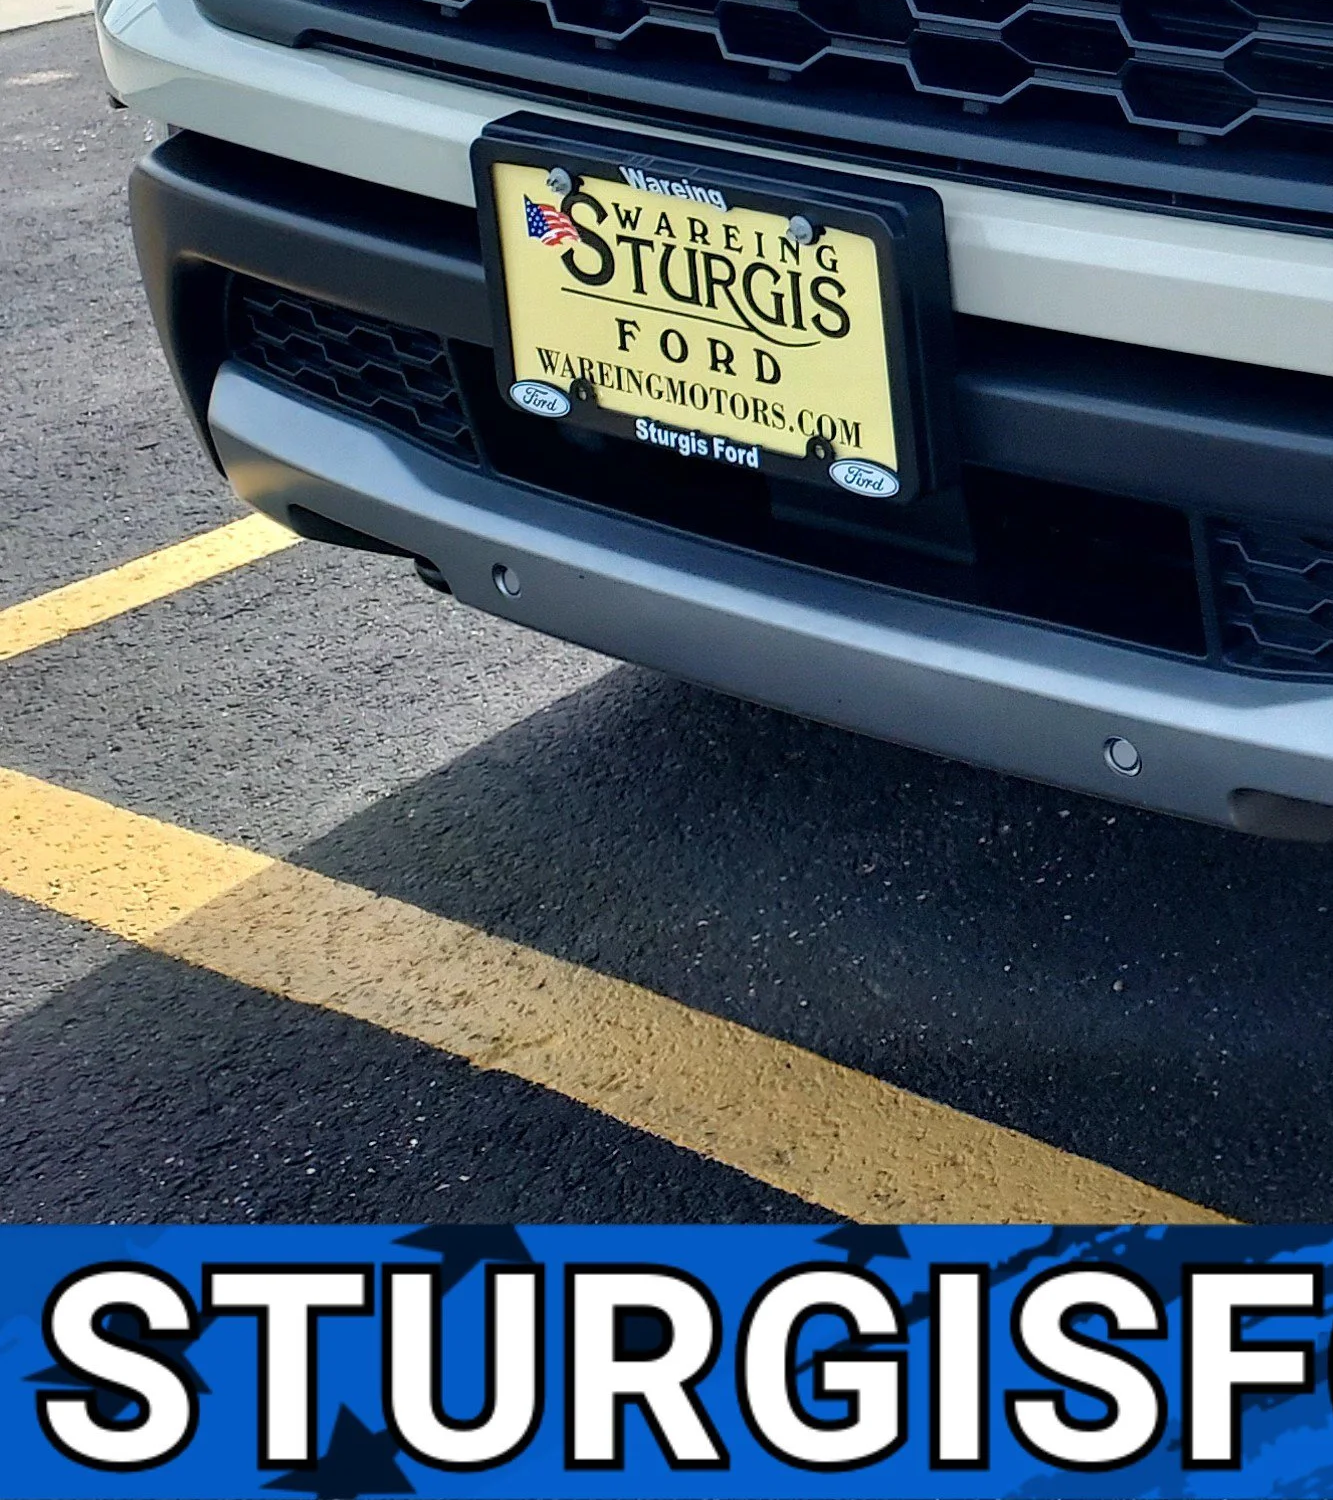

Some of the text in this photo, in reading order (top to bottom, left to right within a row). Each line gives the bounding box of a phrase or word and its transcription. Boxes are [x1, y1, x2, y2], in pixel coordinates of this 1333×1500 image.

[618, 165, 726, 212] Wareing
[611, 202, 840, 273] WAREING
[560, 193, 851, 347] STURGIS
[615, 318, 783, 386] FORD
[521, 386, 558, 414] Ford
[536, 346, 863, 449] WAREINGMOTORS.COM
[635, 418, 760, 469] Sturgis Ford
[844, 466, 886, 493] Ford
